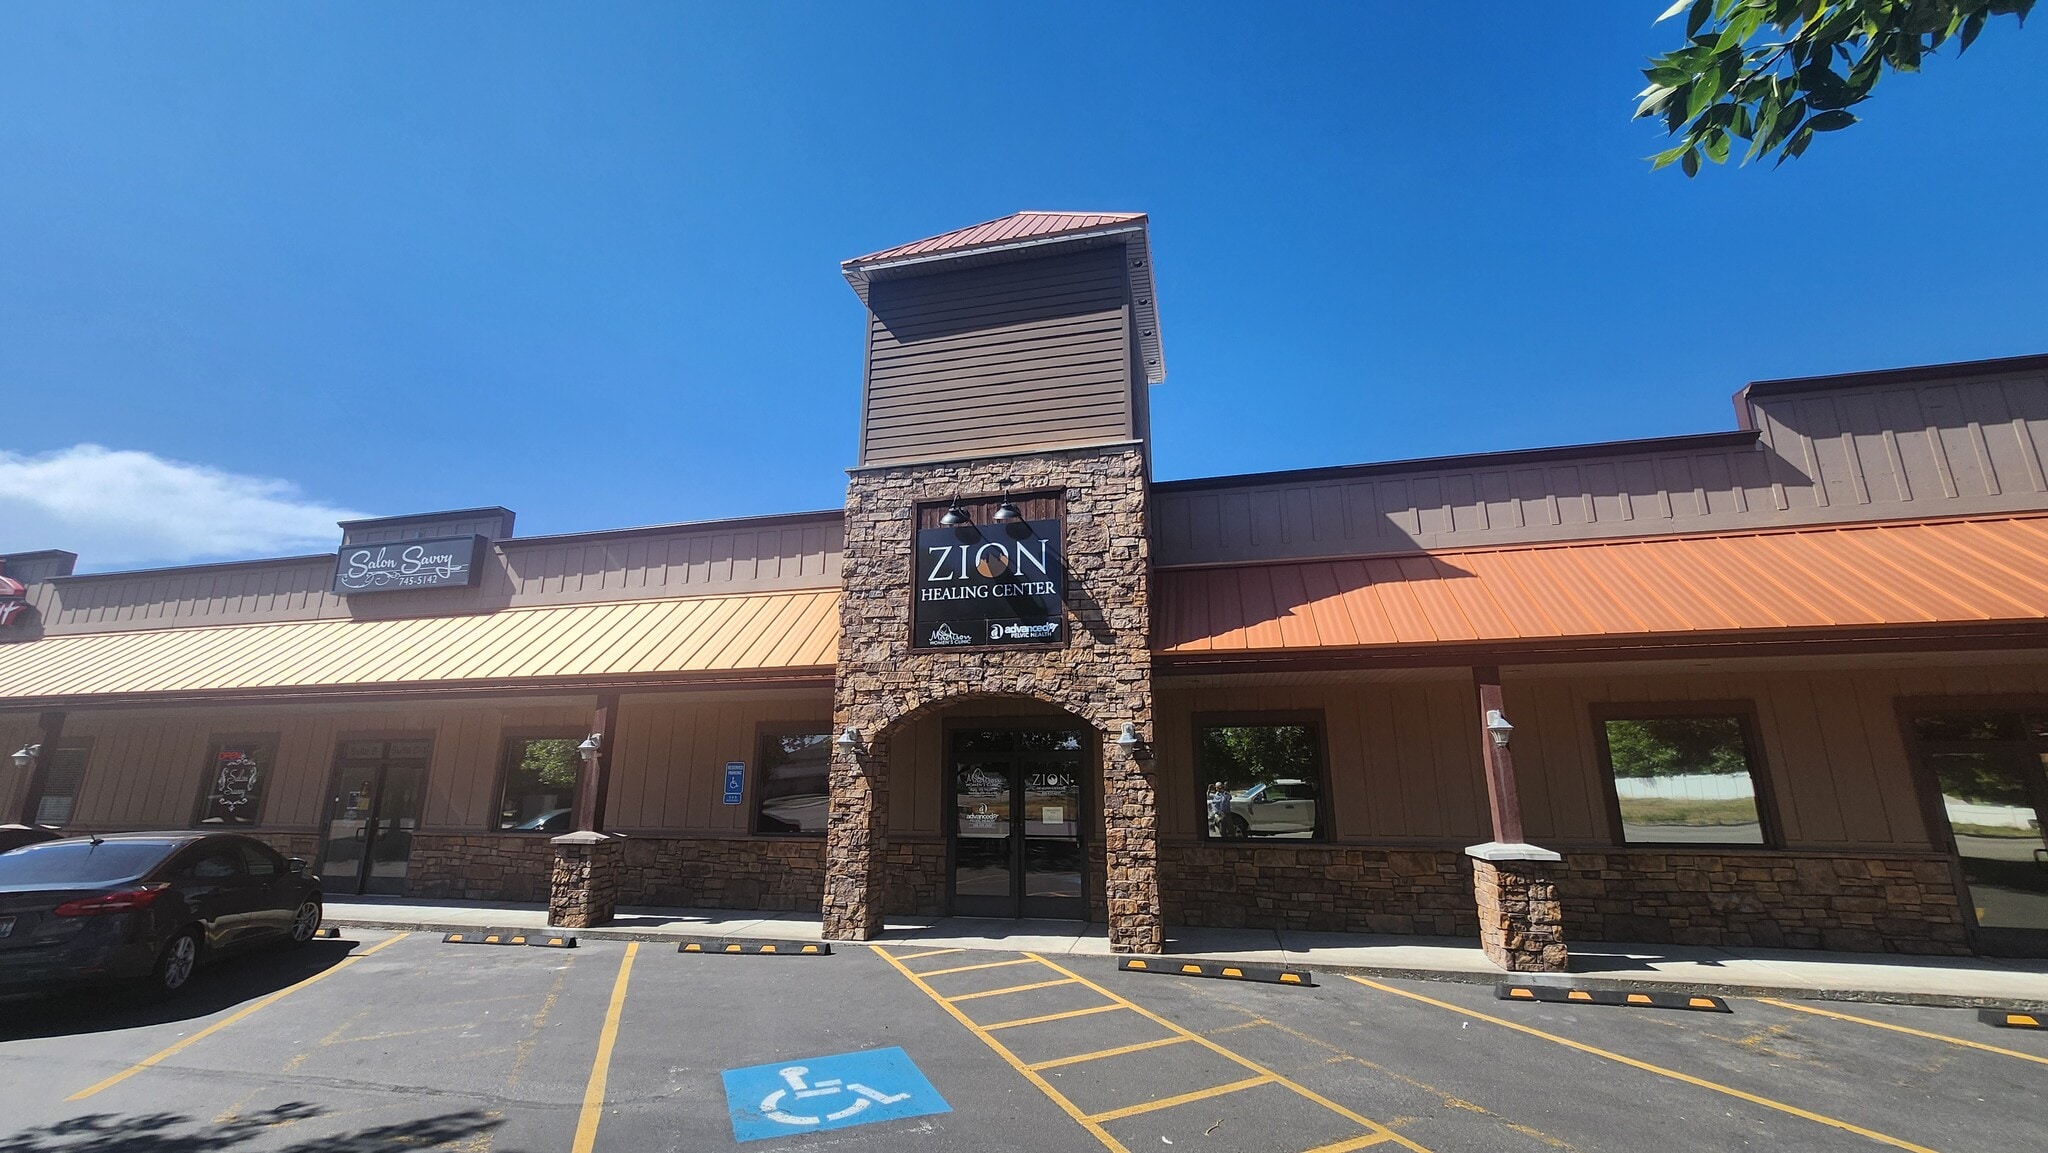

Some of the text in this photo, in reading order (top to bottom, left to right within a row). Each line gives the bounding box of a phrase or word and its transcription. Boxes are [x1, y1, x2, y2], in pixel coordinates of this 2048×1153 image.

[348, 546, 462, 578] Salon Savvy
[928, 539, 1049, 581] ZION
[399, 575, 438, 586] 745-5142
[921, 581, 1056, 601] HEALING CENTER
[1010, 631, 1029, 639] PELVIC
[1032, 773, 1070, 786] ZION
